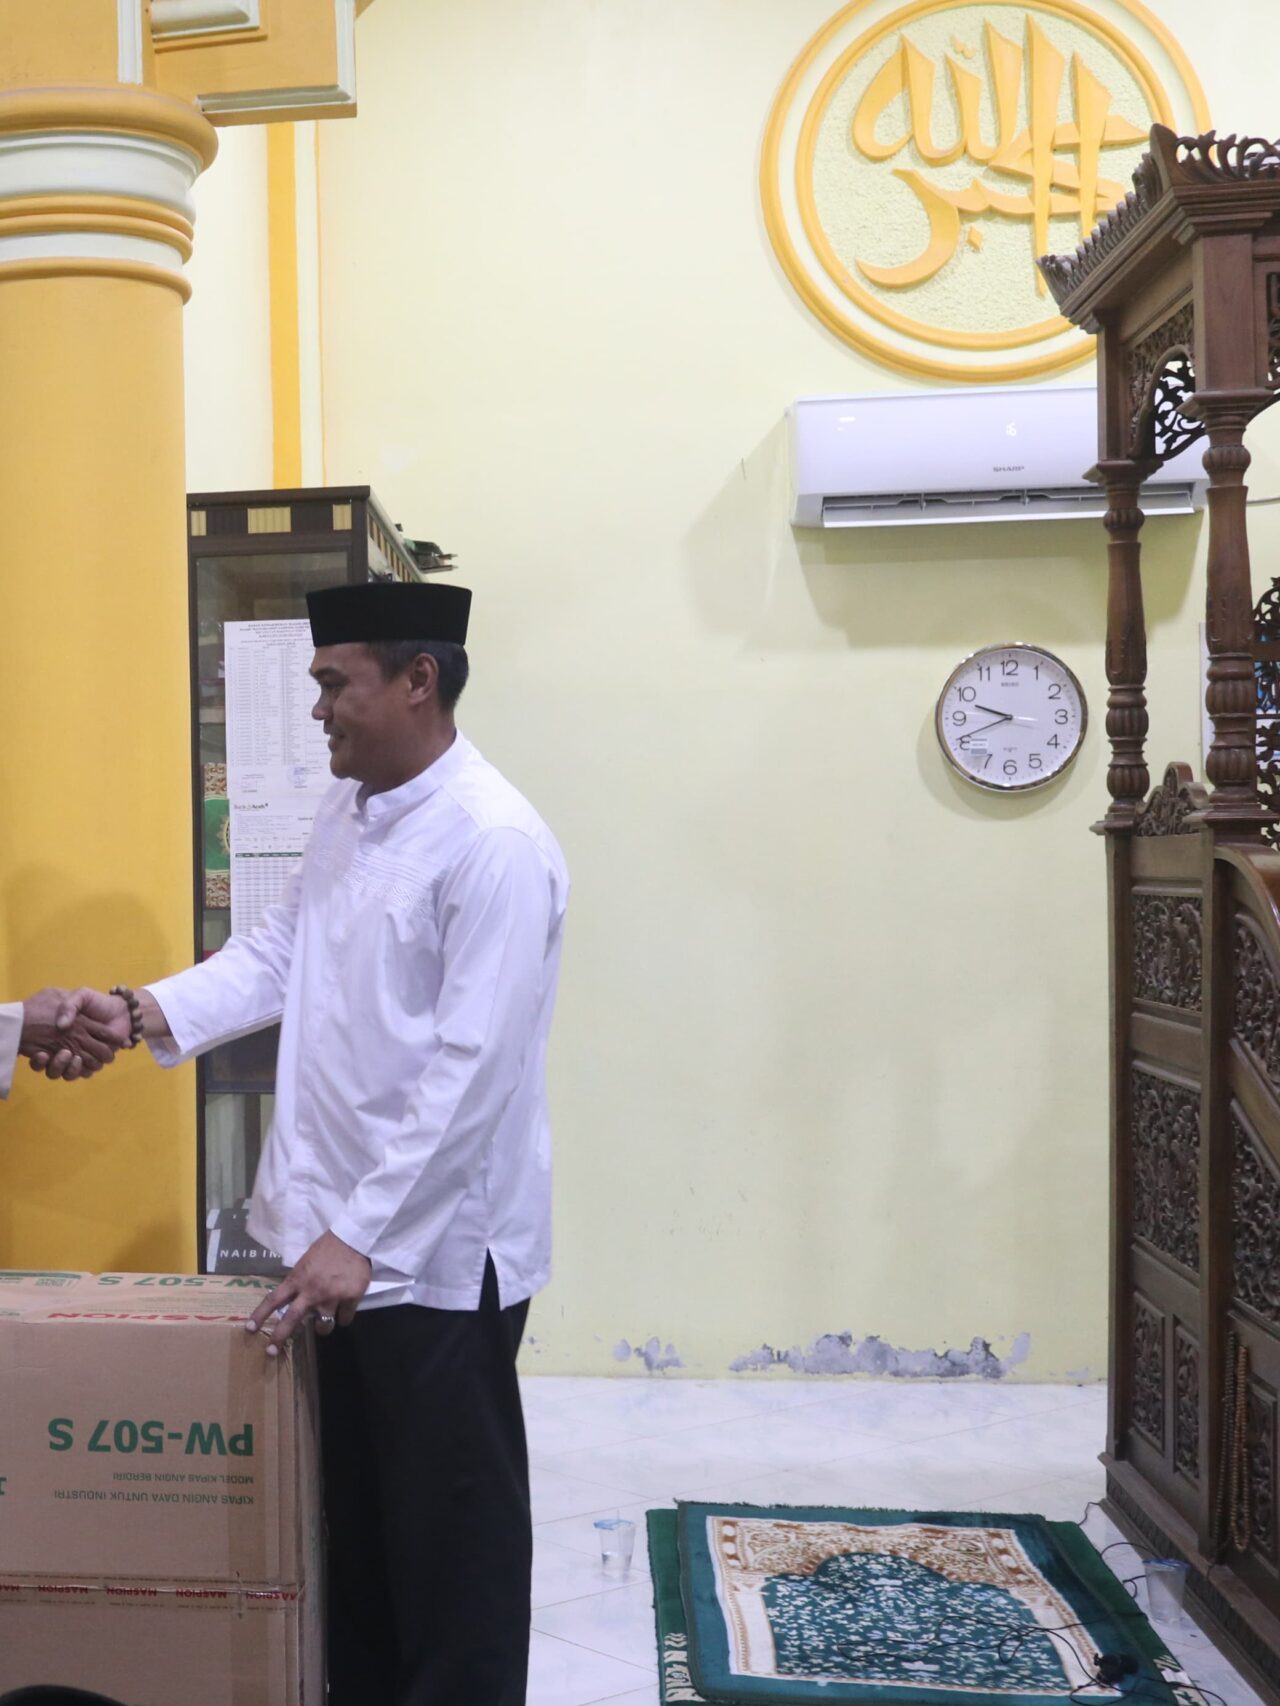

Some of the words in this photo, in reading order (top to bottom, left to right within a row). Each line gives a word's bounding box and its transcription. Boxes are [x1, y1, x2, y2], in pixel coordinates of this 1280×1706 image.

[977, 666, 991, 681] 11
[1000, 659, 1019, 676] 12
[1033, 665, 1040, 680] 1
[957, 686, 976, 702] 10
[1048, 683, 1061, 699] 2
[952, 710, 967, 726] 9
[1054, 708, 1068, 725] 3
[1046, 733, 1060, 749] 4
[984, 753, 993, 769] 7
[1003, 759, 1017, 775] 6
[1028, 753, 1042, 769] 5
[220, 1249, 257, 1258] NAIB
[98, 1276, 124, 1286] S
[47, 1418, 74, 1451] S
[87, 1419, 254, 1456] PW-507
[113, 1472, 153, 1482] BERDIRI
[155, 1473, 185, 1483] ANGIN
[188, 1473, 217, 1483] KIPAS
[221, 1474, 254, 1484] MODEL
[54, 1490, 106, 1500] INDUSTRI
[110, 1491, 148, 1502] UNTUK
[152, 1493, 179, 1503] DAYA
[183, 1494, 218, 1504] ANGIN
[222, 1495, 254, 1505] KIPAS
